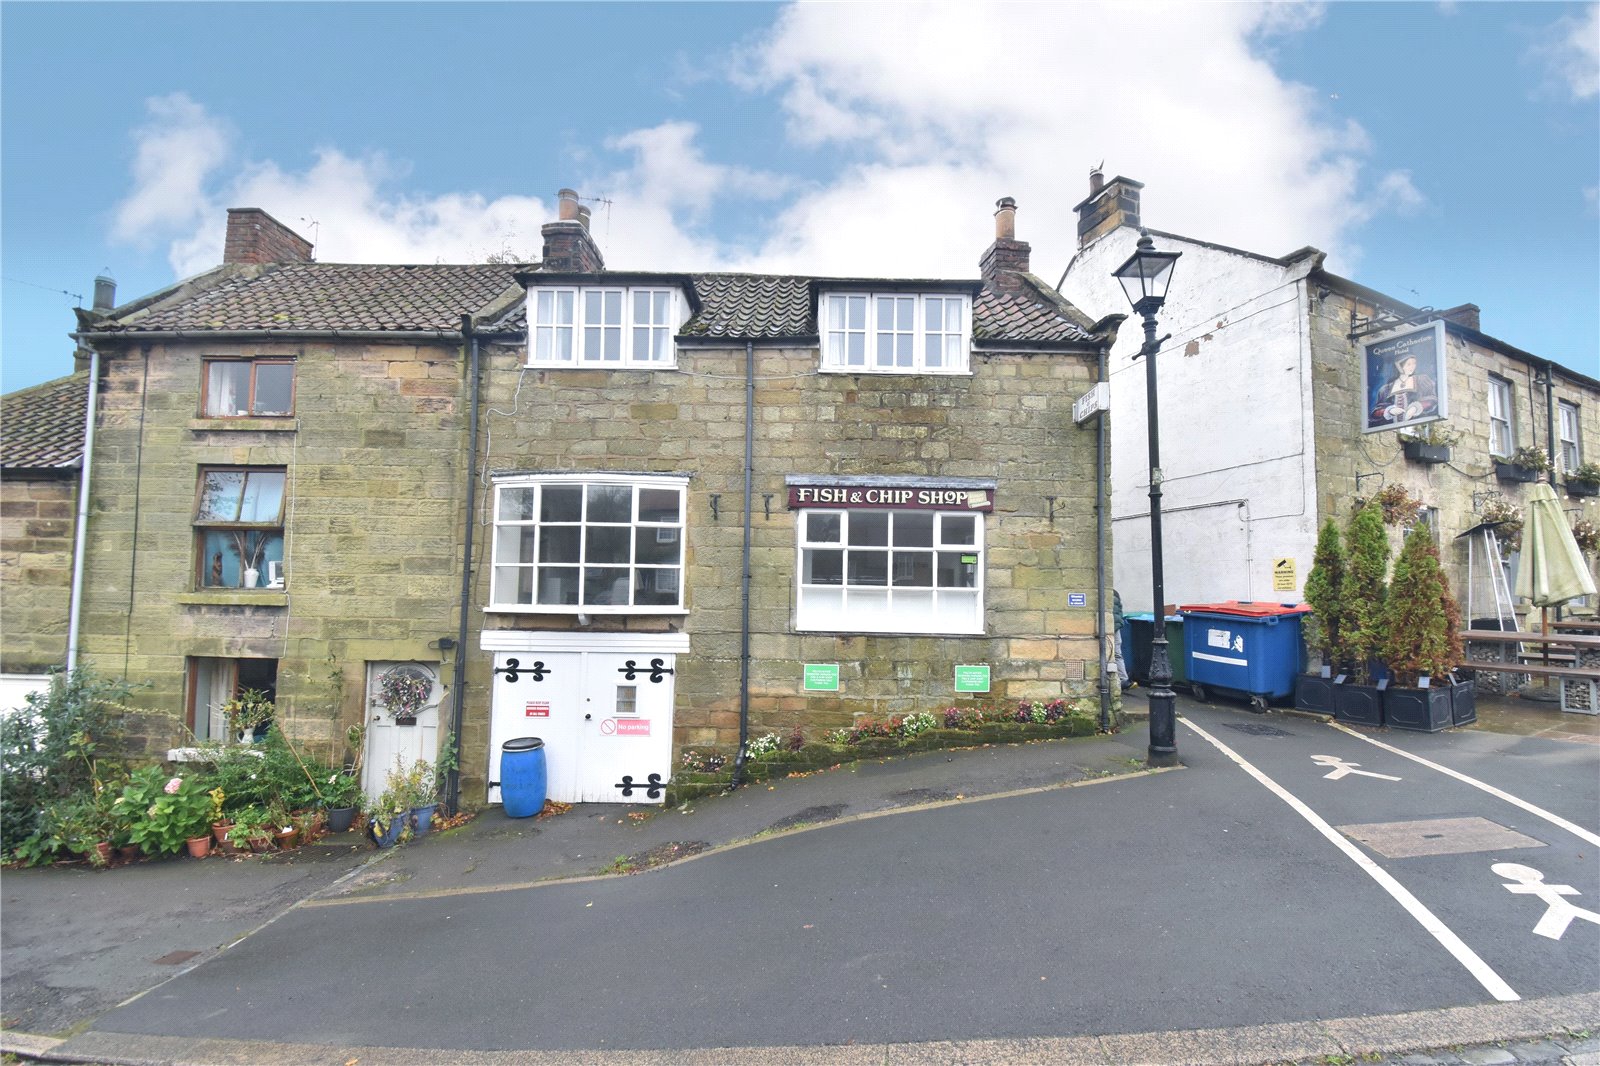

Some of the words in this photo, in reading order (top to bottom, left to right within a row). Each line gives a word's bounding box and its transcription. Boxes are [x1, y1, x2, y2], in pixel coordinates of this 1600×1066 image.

[1373, 346, 1396, 356] Queen
[1081, 388, 1096, 406] FISH
[1079, 400, 1098, 419] CHIPS
[797, 488, 848, 503] FISH
[850, 490, 863, 503] &
[865, 489, 914, 504] CHIP
[918, 490, 968, 505] SHOP
[627, 723, 649, 732] parking
